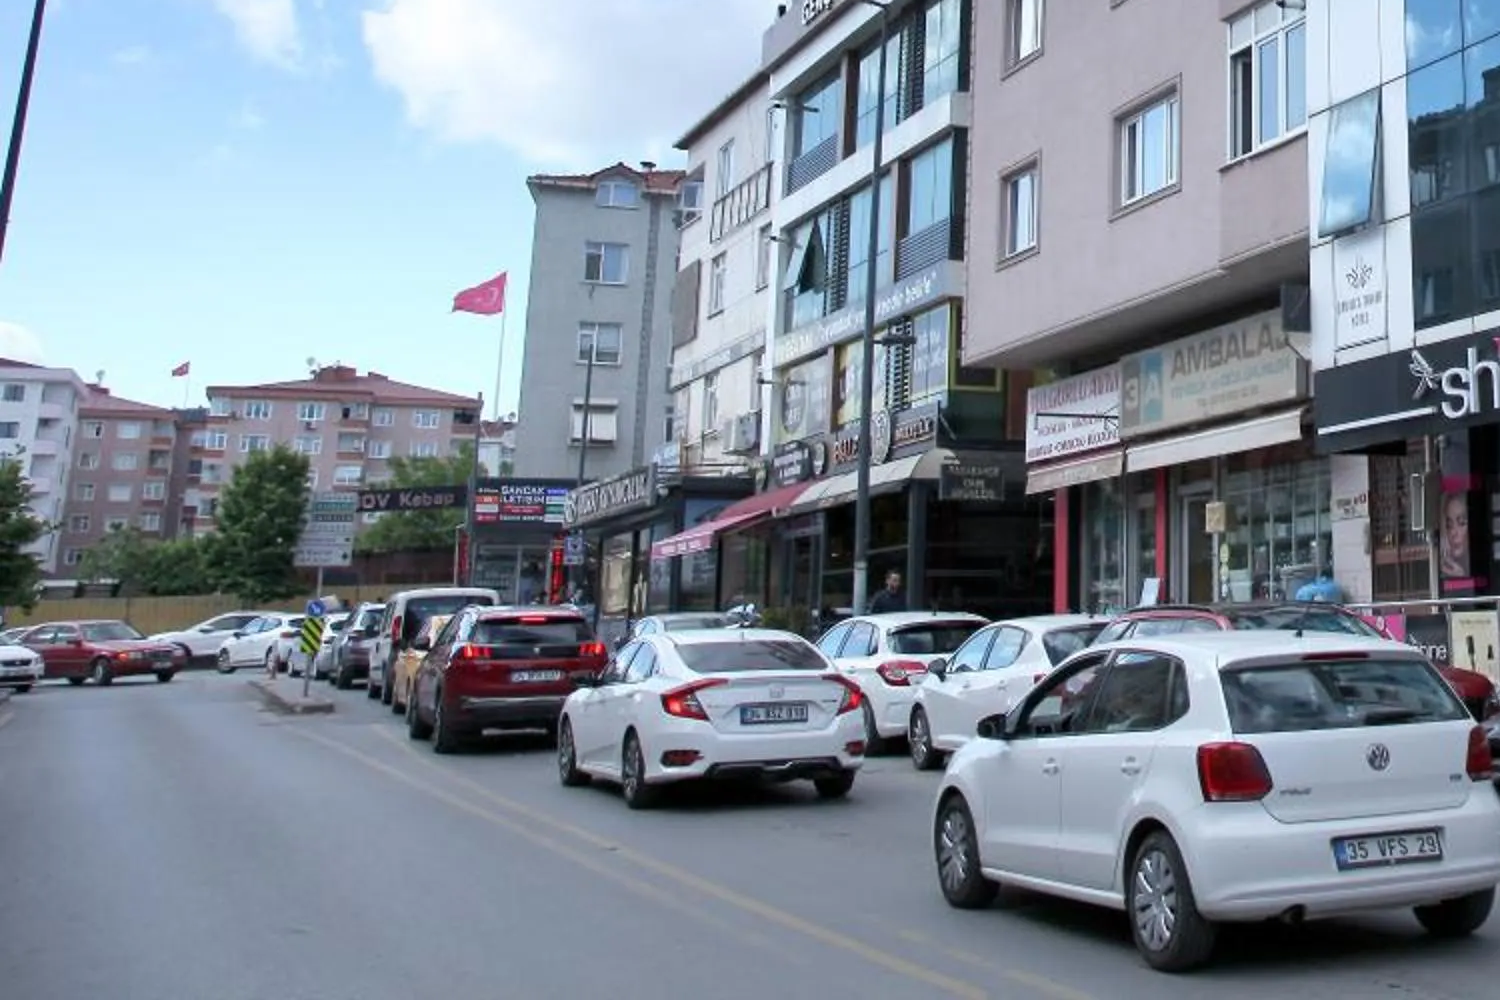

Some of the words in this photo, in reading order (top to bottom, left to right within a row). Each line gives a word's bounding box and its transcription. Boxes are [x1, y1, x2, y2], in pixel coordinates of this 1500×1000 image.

[1347, 842, 1369, 860] 35
[1377, 838, 1409, 857] VFS
[1416, 834, 1437, 854] 29
